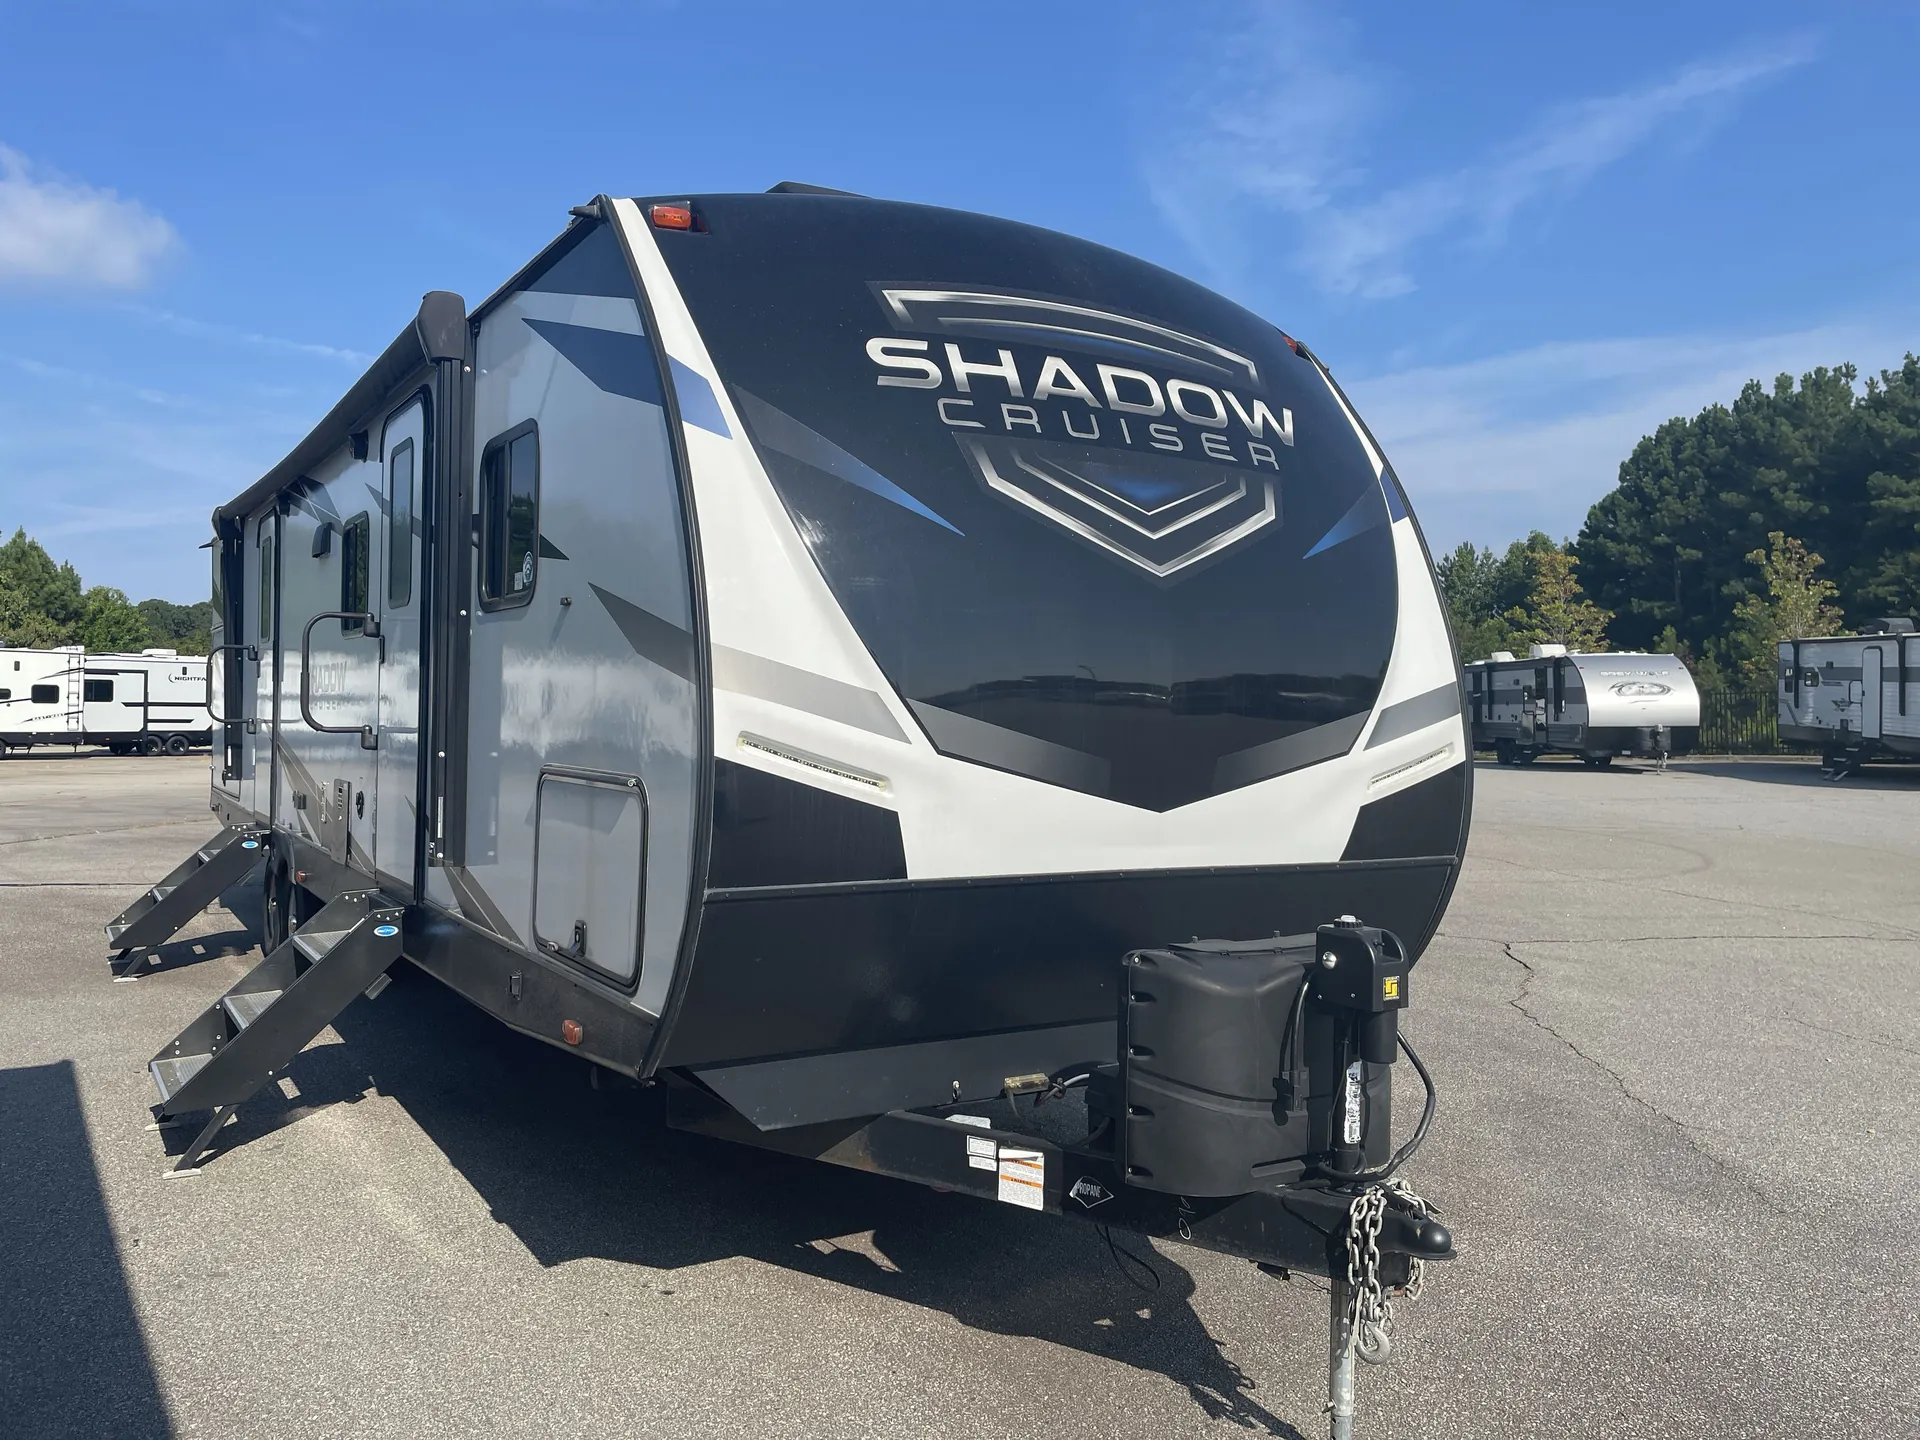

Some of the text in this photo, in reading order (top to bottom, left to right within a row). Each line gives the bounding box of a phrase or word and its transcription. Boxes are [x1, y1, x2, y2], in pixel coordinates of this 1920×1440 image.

[865, 336, 1295, 447] SHADOW
[937, 397, 1280, 471] CRUISER
[1076, 1181, 1101, 1198] PROPANE
